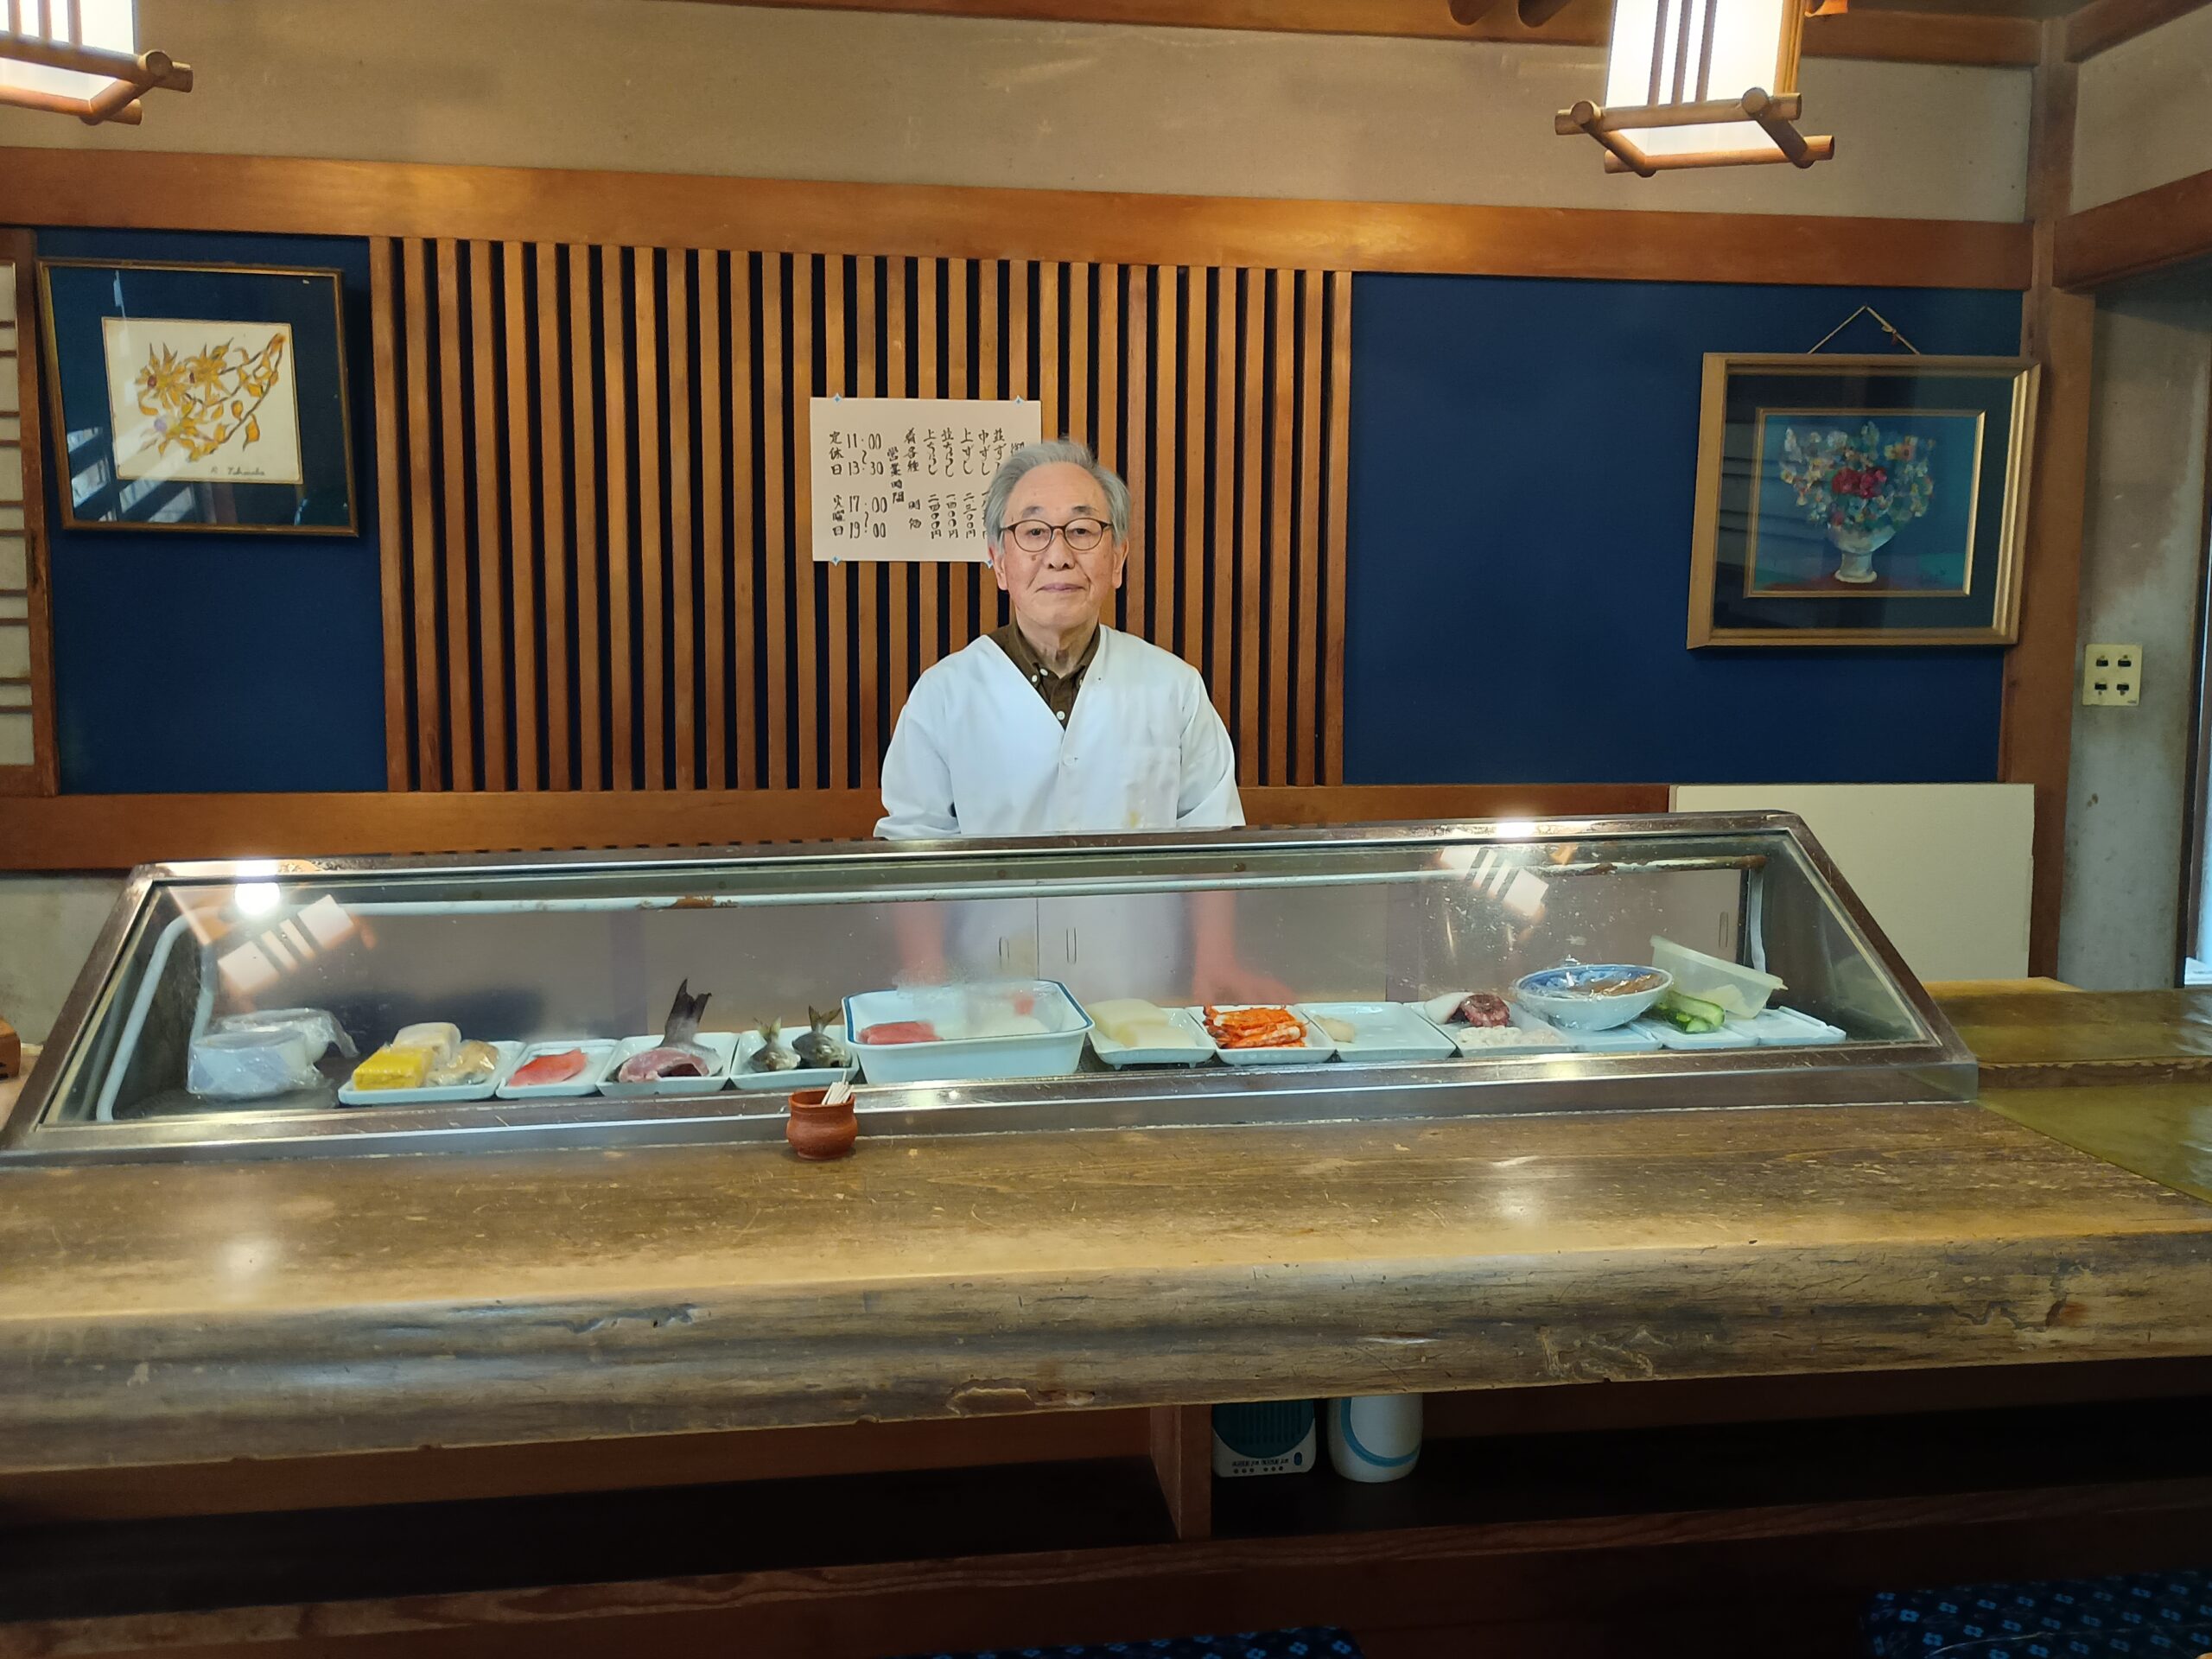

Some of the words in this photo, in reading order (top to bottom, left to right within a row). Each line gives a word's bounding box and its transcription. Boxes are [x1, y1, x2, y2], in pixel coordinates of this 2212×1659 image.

[829, 430, 844, 475] 定休日
[923, 429, 938, 475] 上ちらし
[941, 427, 955, 478] 並ちらし
[832, 494, 846, 536] 火曜日
